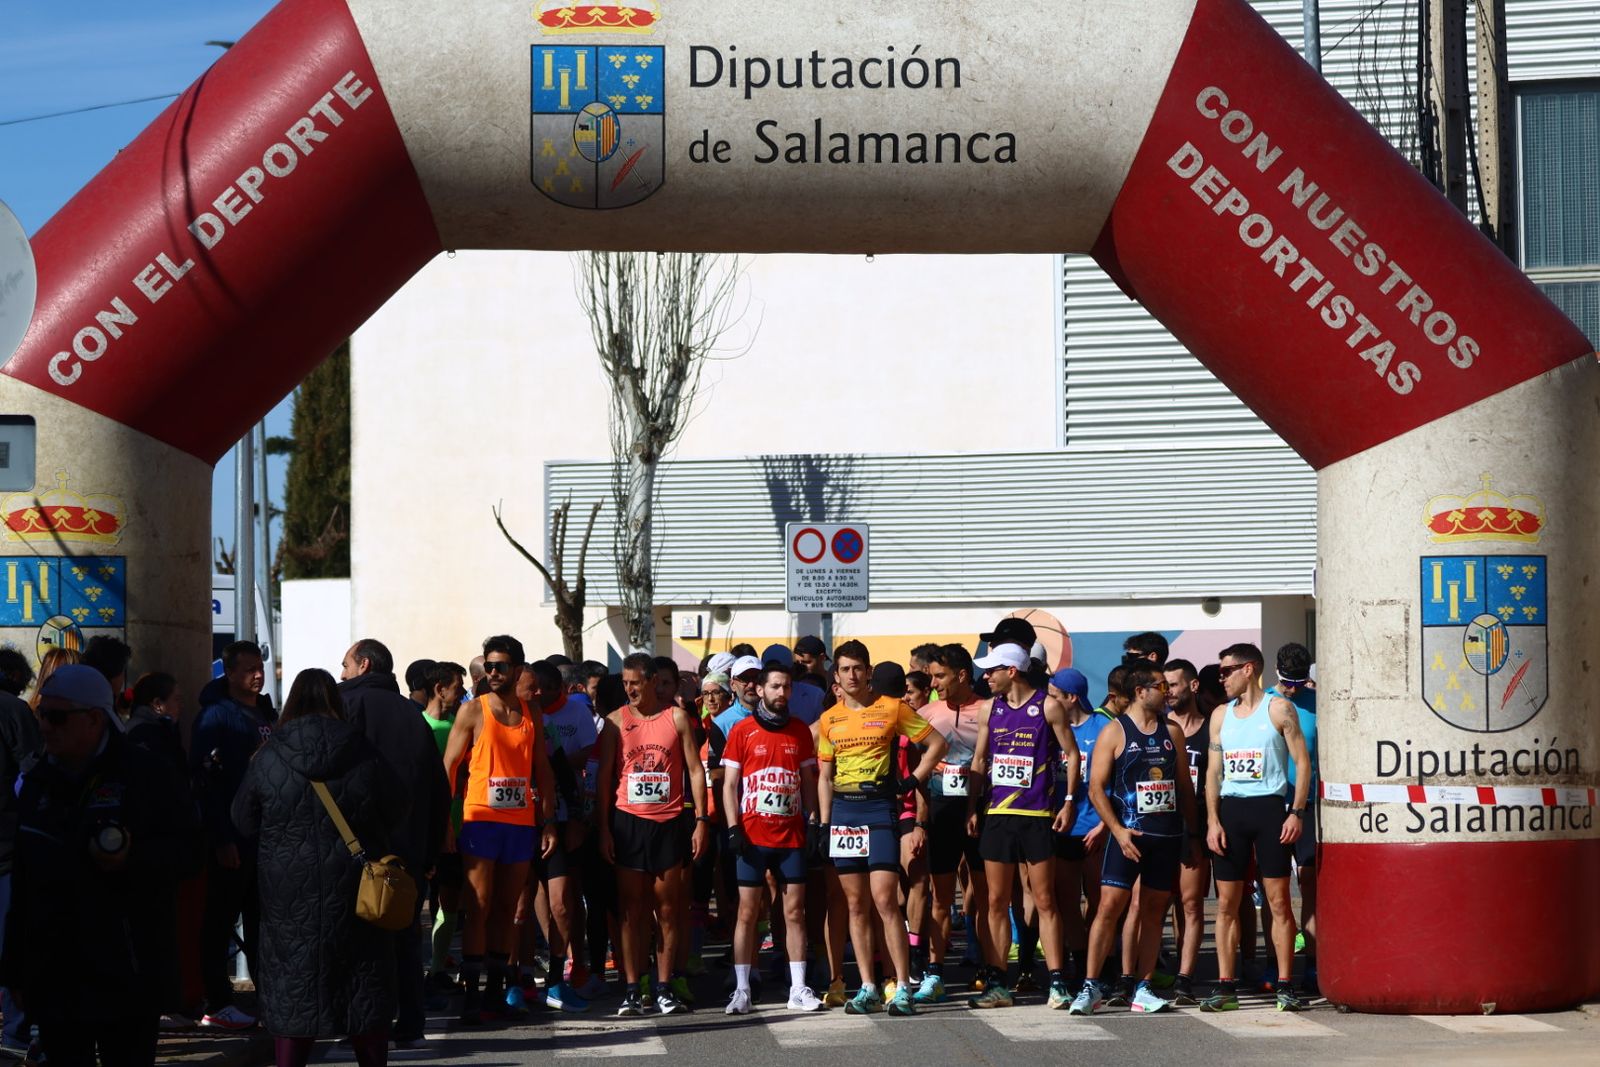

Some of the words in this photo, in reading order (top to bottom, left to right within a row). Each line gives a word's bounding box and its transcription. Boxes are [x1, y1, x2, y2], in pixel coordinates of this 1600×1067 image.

[689, 44, 961, 100] Diputación
[689, 128, 732, 165] de
[753, 117, 1018, 166] Salamanca
[48, 296, 138, 386] CON
[132, 252, 195, 304] EL
[188, 69, 374, 250] DEPORTE
[1195, 86, 1284, 173] CON
[1277, 168, 1480, 369] NUESTROS
[1166, 141, 1422, 395] DEPORTISTAS
[997, 765, 1025, 780] 355
[1229, 759, 1255, 773] 362
[1377, 737, 1580, 786] Diputación
[495, 787, 521, 802] 396
[634, 782, 664, 797] 354
[763, 793, 791, 808] 414
[1144, 791, 1171, 806] 392
[1360, 802, 1389, 834] de
[1406, 801, 1593, 834] Salamanca
[836, 836, 863, 849] 403
